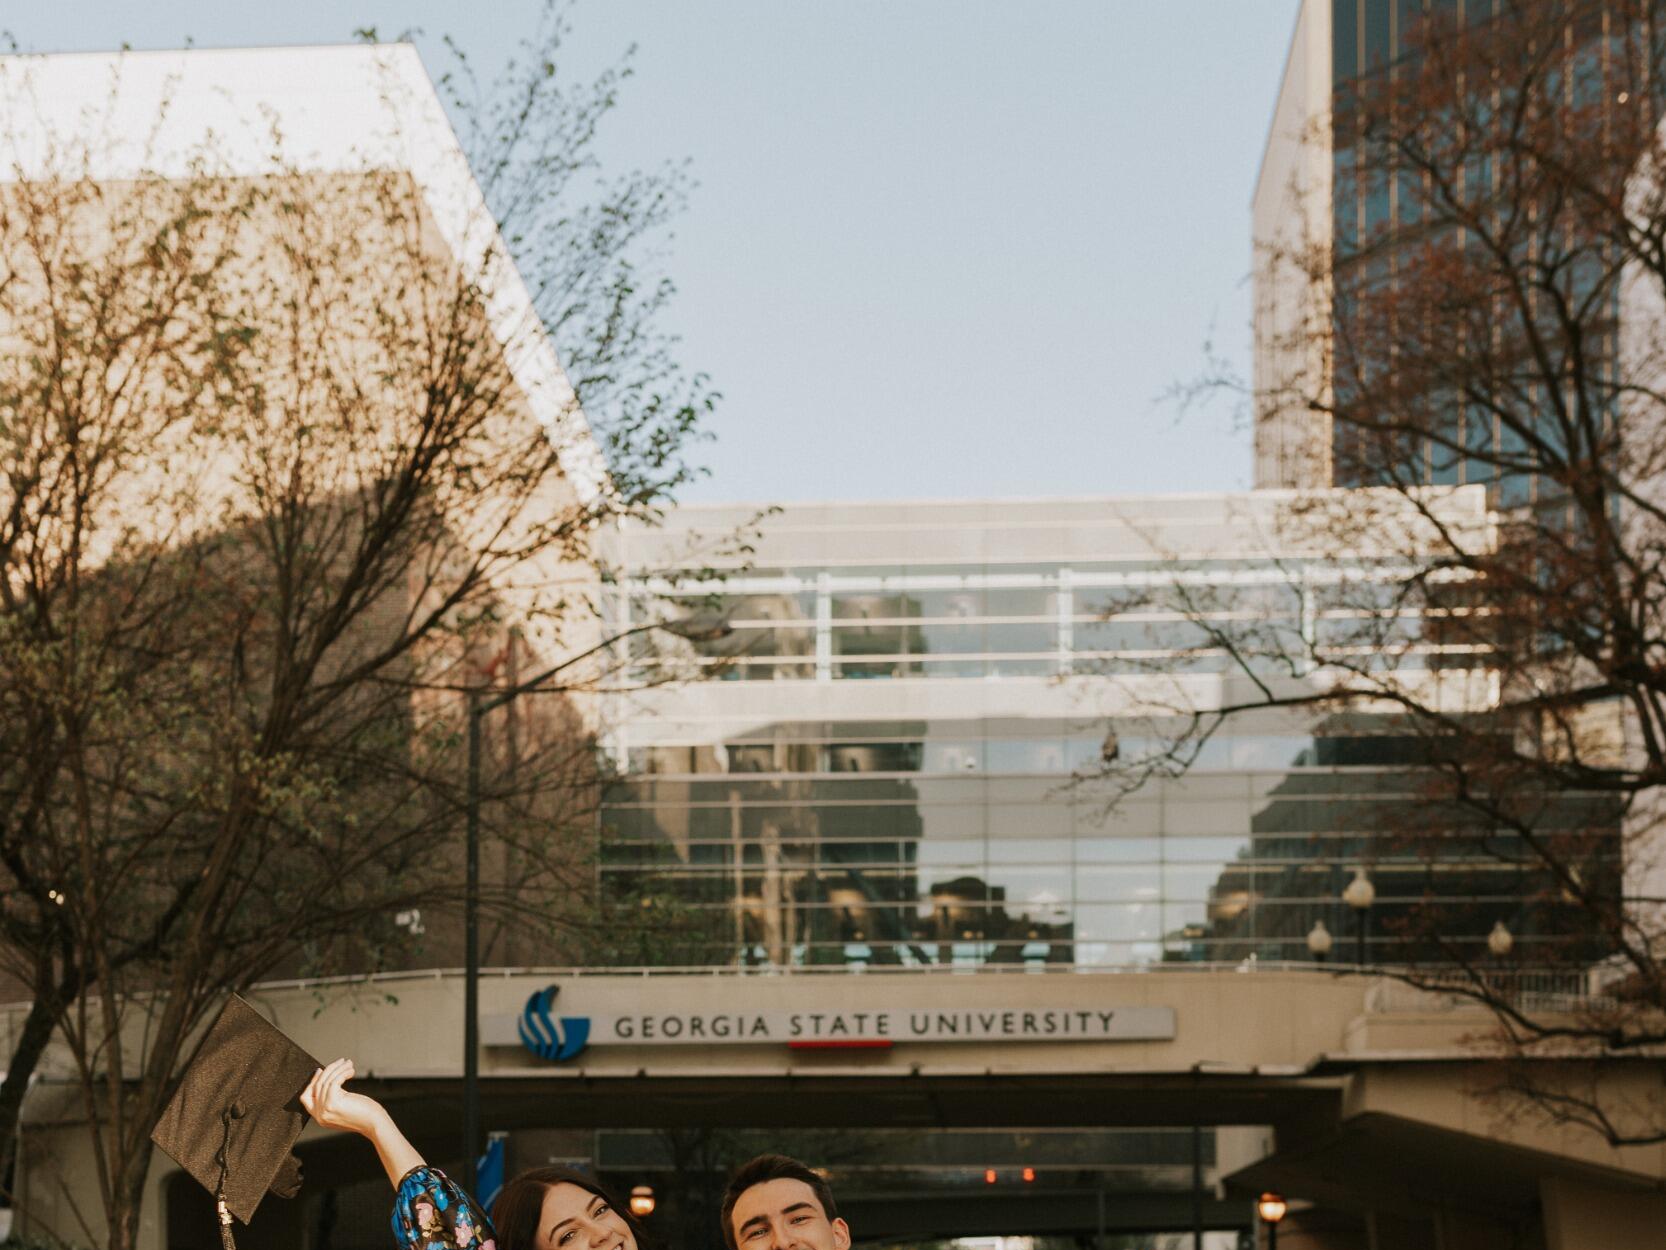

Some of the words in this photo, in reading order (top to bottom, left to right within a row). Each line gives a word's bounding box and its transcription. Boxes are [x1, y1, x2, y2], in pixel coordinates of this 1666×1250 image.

[615, 1015, 770, 1039] GEORGIA
[790, 1013, 890, 1037] STATE
[911, 1011, 1115, 1035] UNIVERSITY
